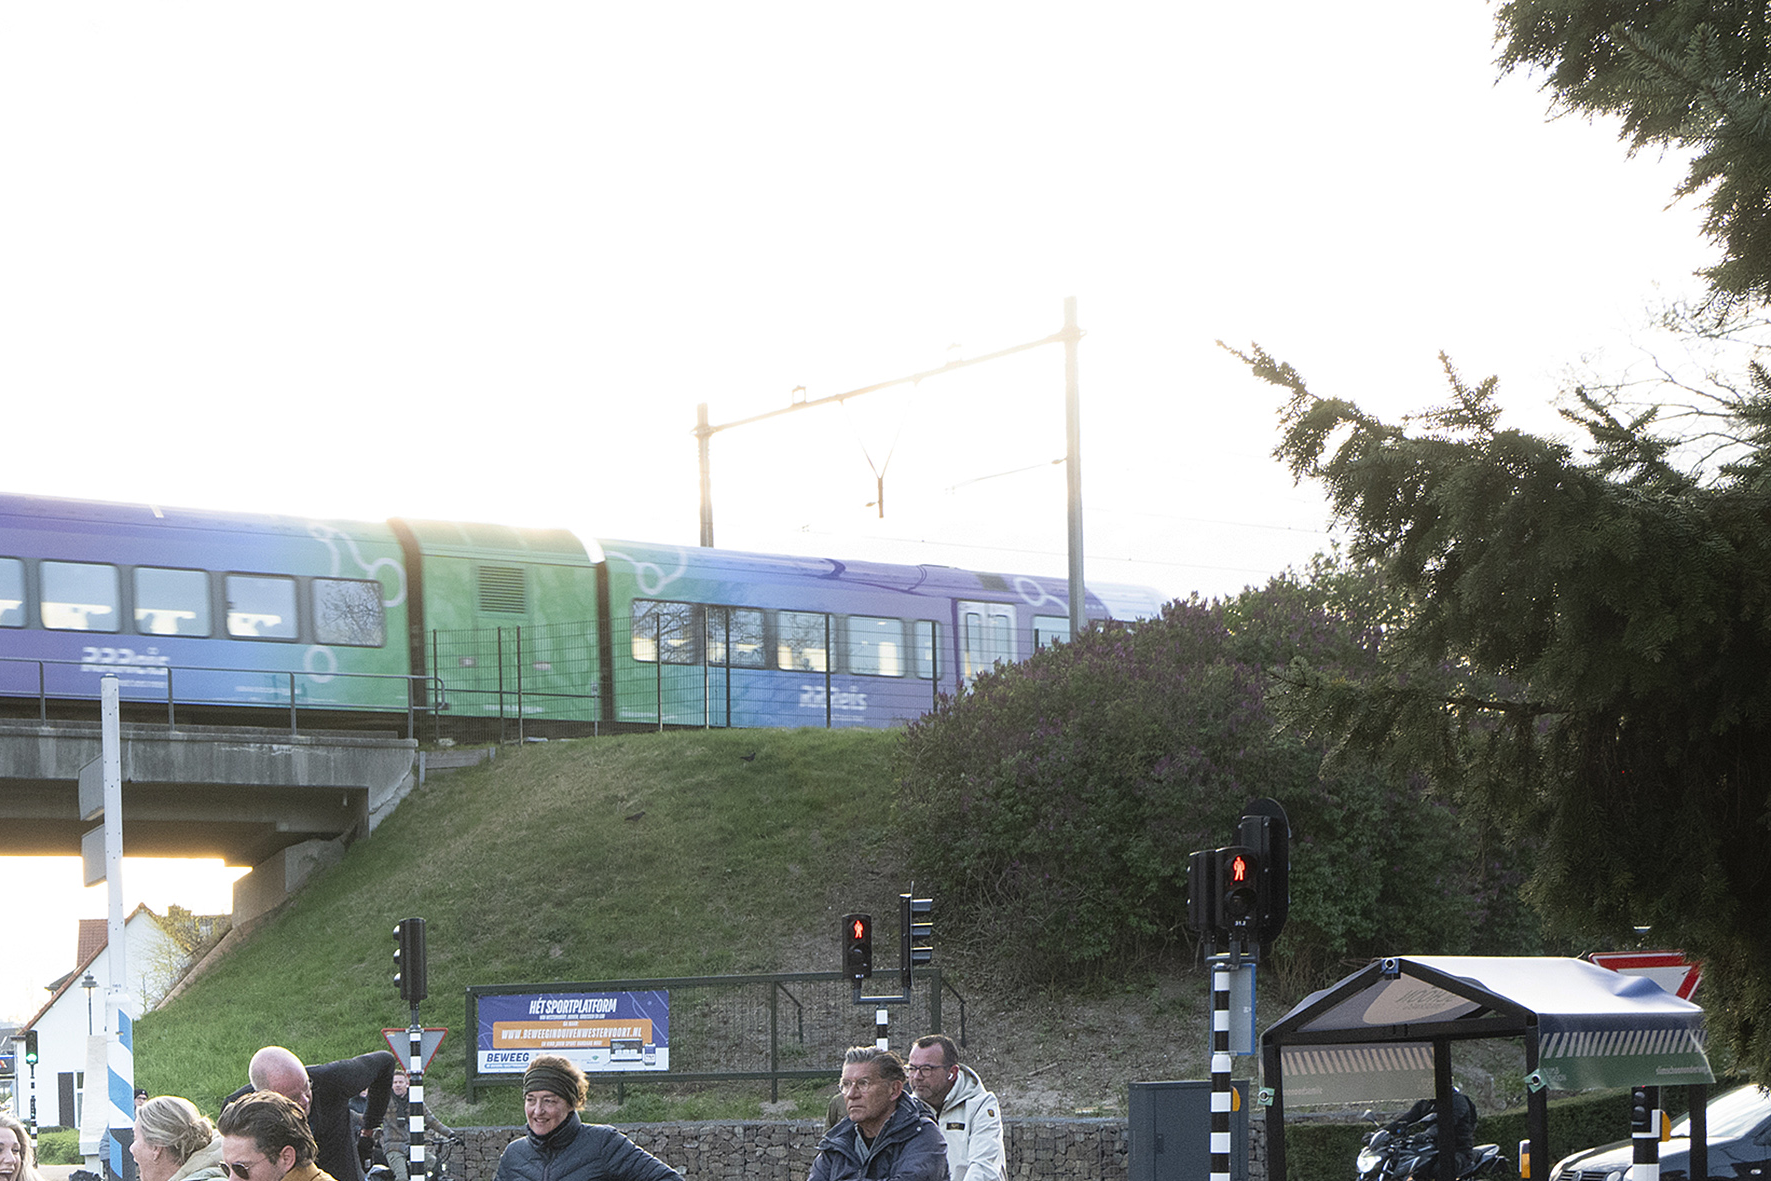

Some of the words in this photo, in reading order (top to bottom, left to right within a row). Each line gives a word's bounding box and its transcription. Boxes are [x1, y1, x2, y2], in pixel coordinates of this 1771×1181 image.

[529, 997, 547, 1015] HÉT
[546, 998, 618, 1014] SPORTPLATFORM
[501, 1026, 642, 1040] WWW.BEWEEGINDUIVENWESTERVOORT.NL
[486, 1052, 530, 1062] BEWEEG
